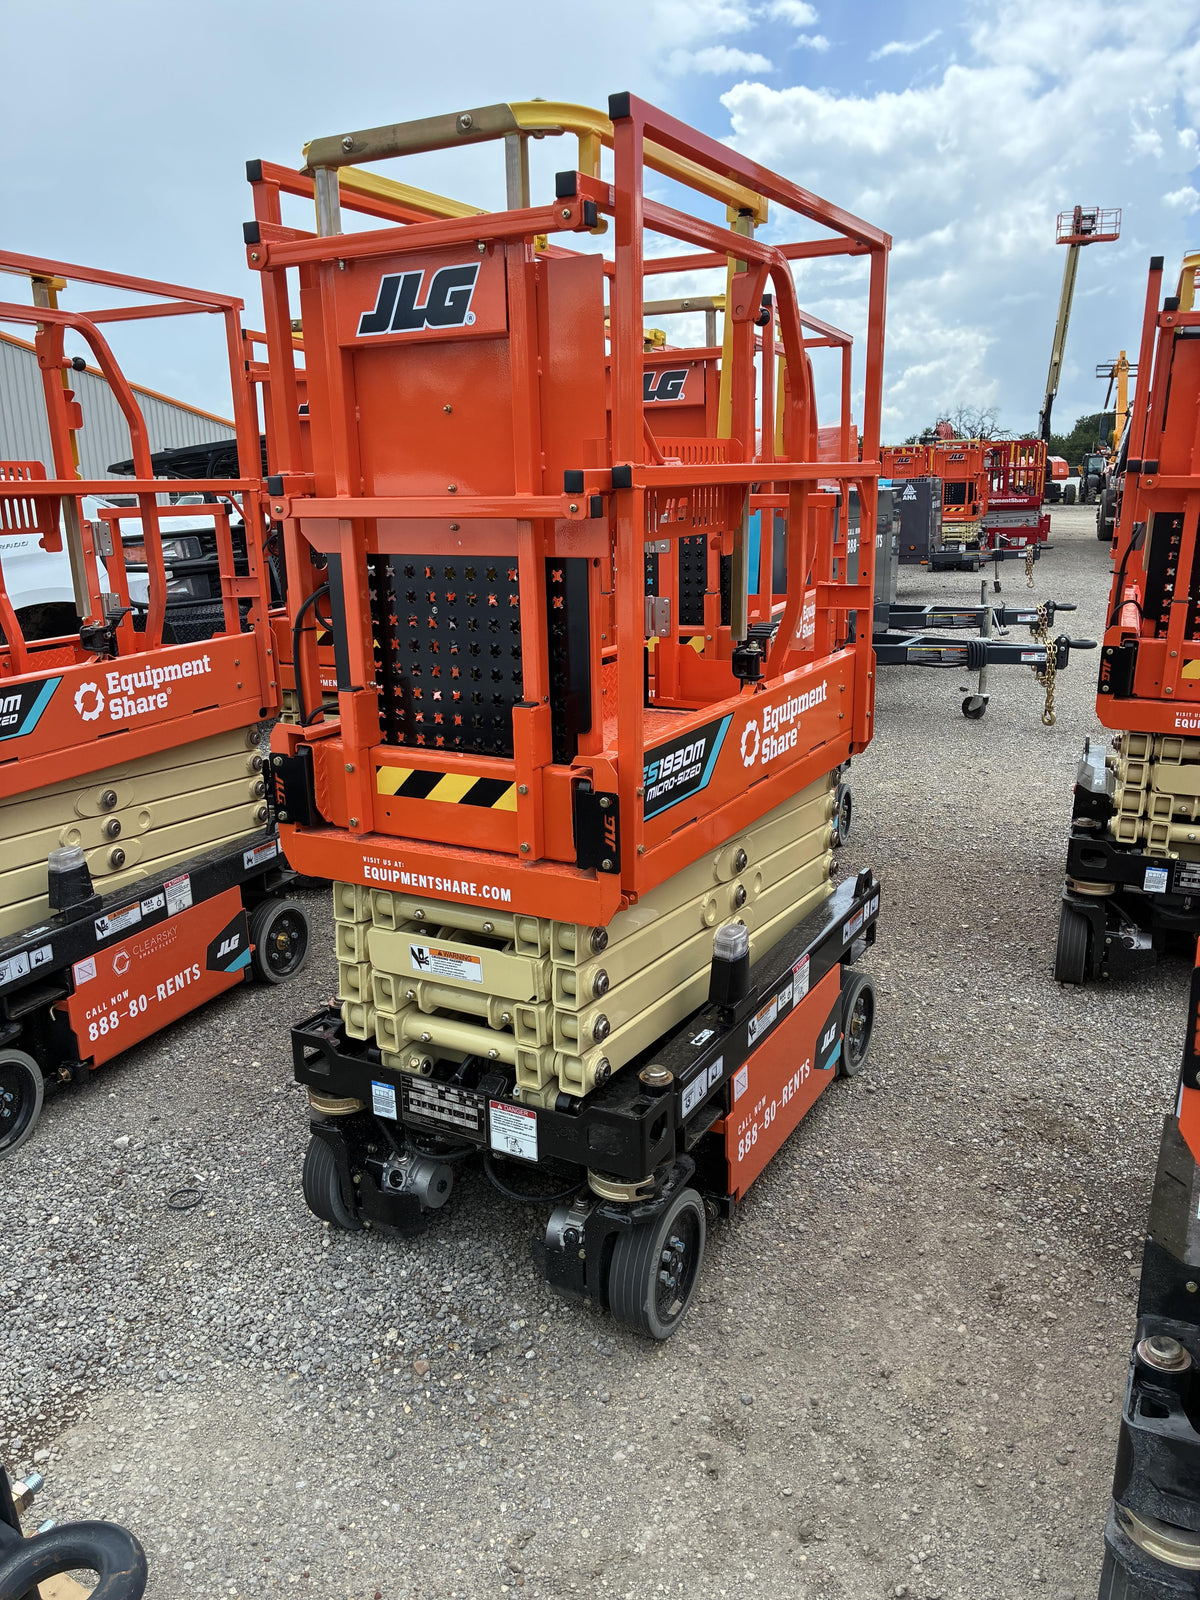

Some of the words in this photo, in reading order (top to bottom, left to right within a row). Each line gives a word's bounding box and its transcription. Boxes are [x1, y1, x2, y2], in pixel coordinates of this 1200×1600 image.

[105, 654, 212, 695] Equipment
[762, 679, 828, 734] Equipment
[646, 762, 702, 802] MICRO-SIZED
[603, 813, 616, 852] JLG
[363, 855, 380, 864] VISIT
[383, 858, 392, 866] US
[364, 865, 512, 903] EQUIPMENTSHARE.COM
[132, 924, 178, 955] CLEARSKY
[217, 933, 240, 958] JLG
[85, 1002, 108, 1020] CALL
[110, 989, 129, 1006] NOW
[88, 963, 201, 1042] 888-80-RENTS
[738, 1057, 811, 1162] 888-80-RENTS
[738, 1113, 752, 1136] CALL
[754, 1094, 767, 1117] NOW
